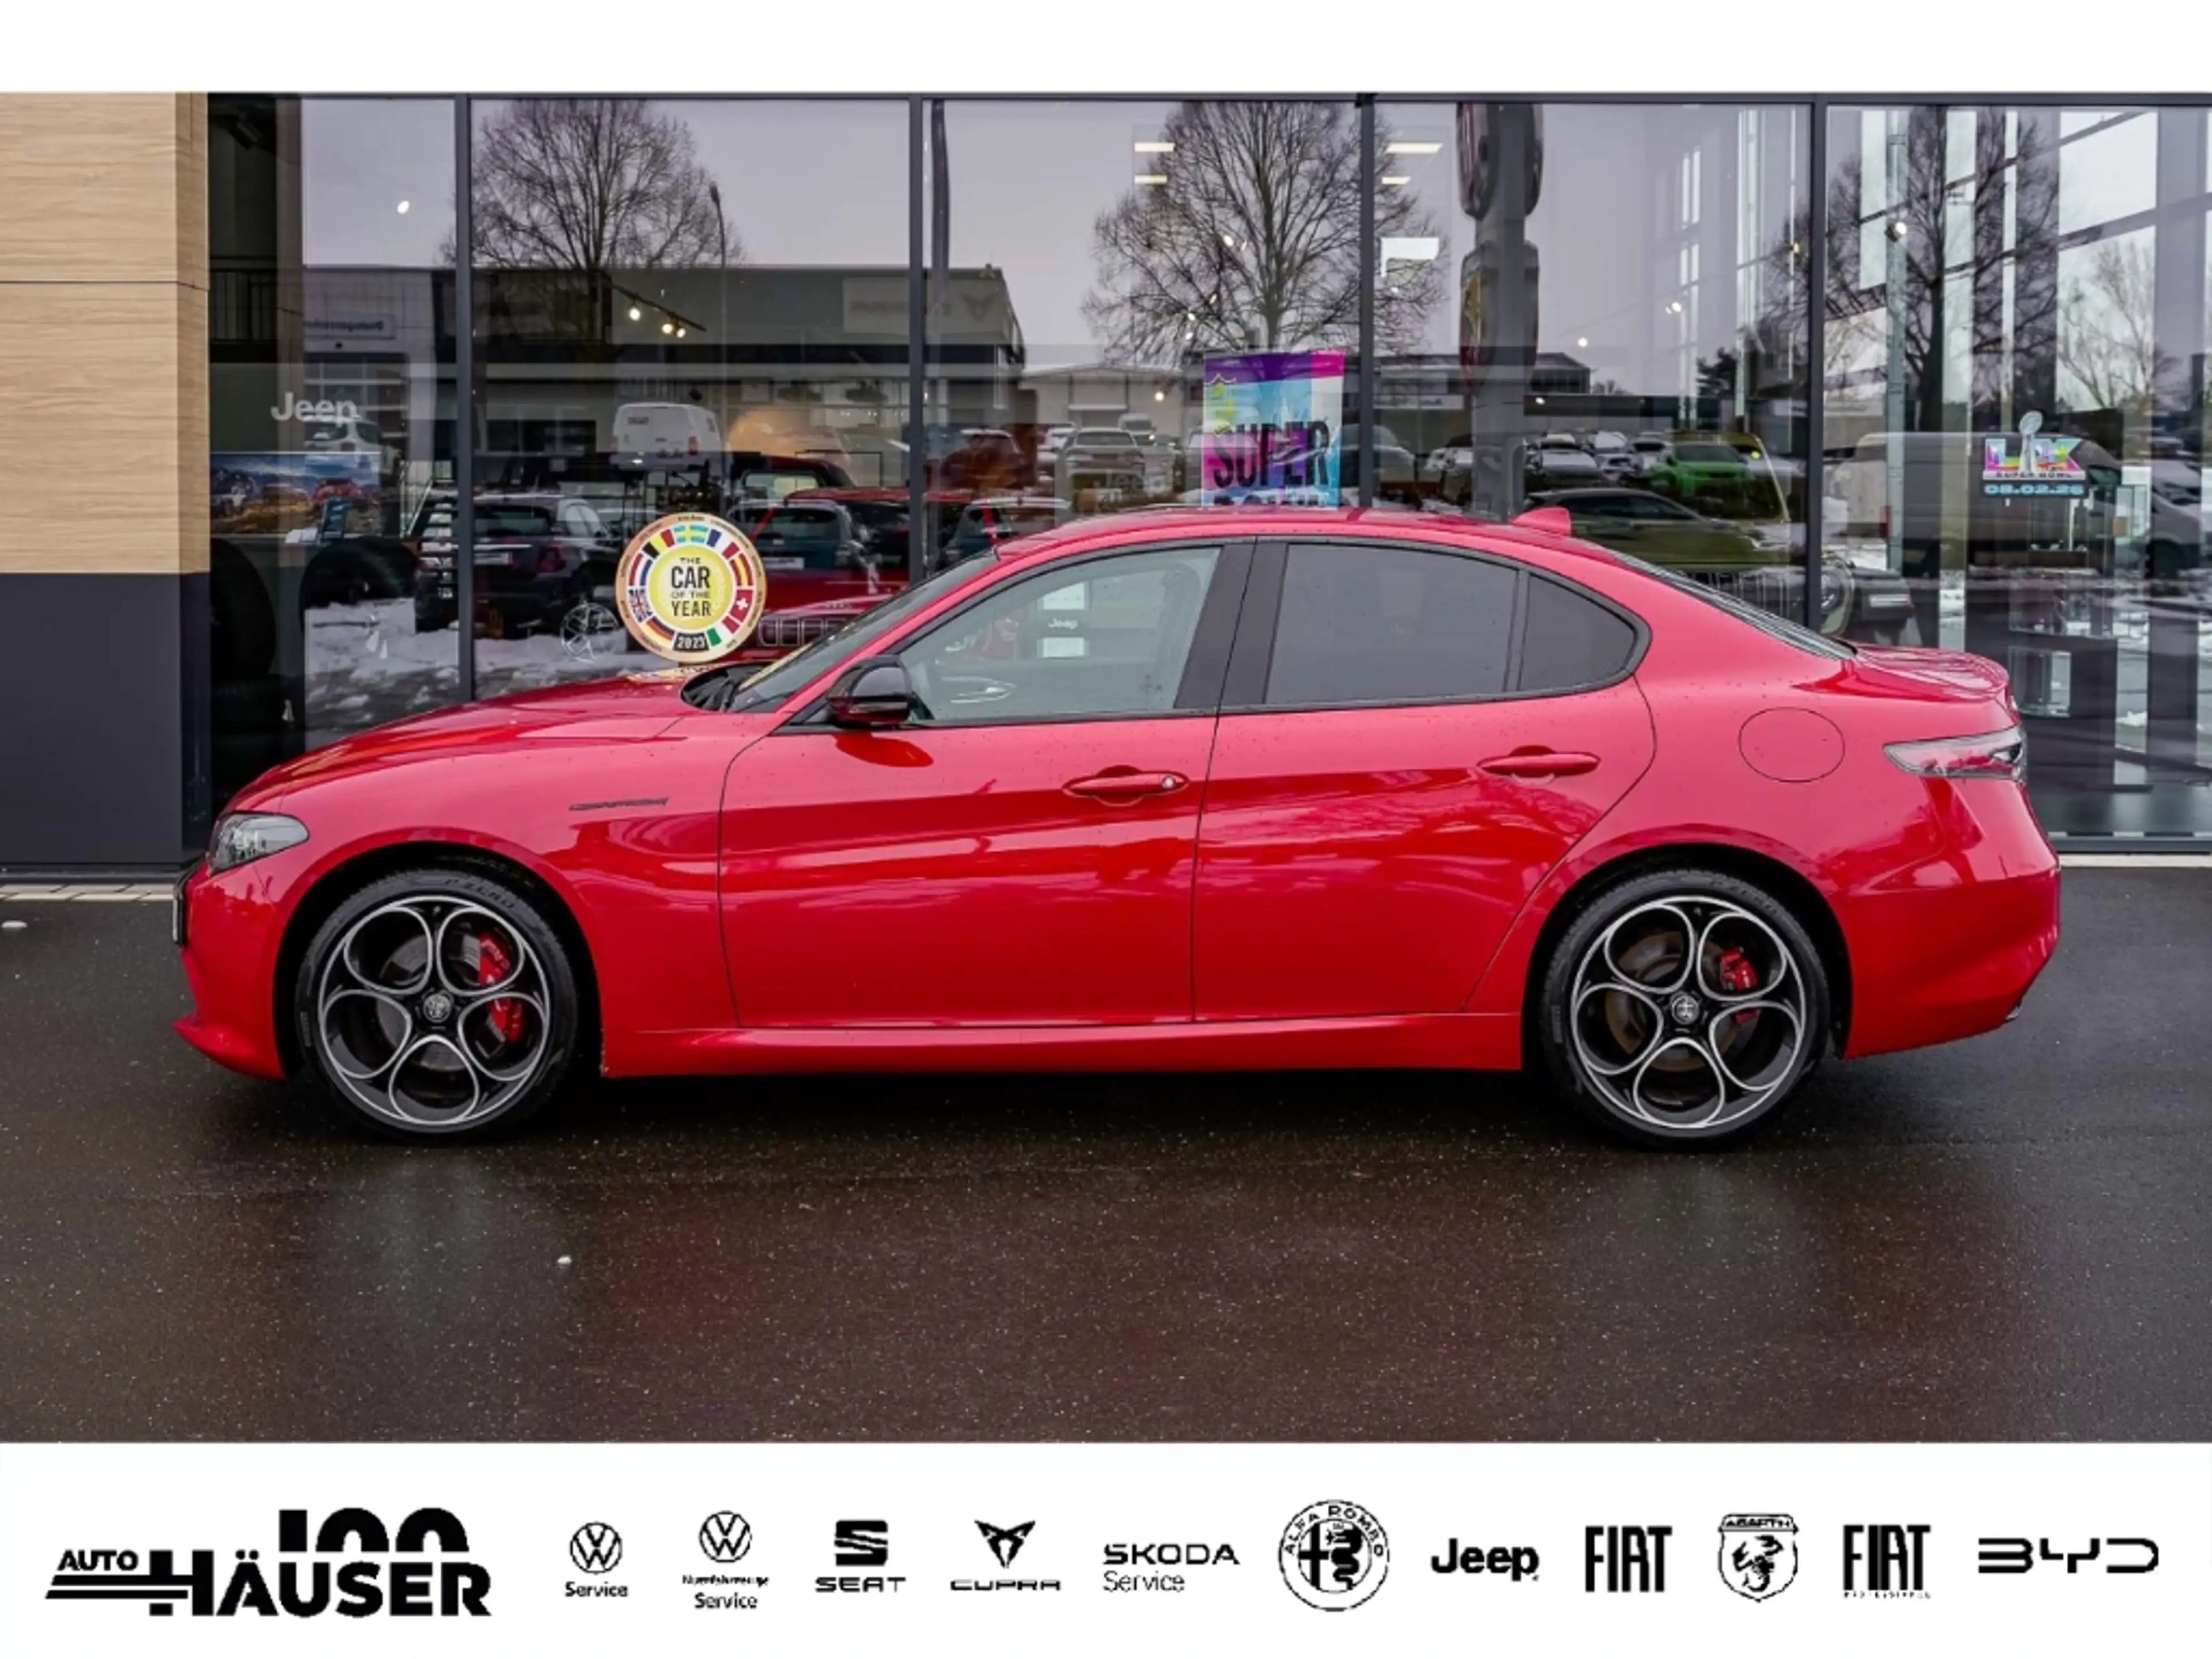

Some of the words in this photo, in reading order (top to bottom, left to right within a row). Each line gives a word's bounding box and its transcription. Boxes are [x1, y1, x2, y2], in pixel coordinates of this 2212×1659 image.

[270, 392, 358, 428] Jeep
[1213, 421, 1330, 488] SUPER
[671, 566, 710, 589] CAR
[671, 601, 711, 616] YEAR
[1048, 618, 1078, 630] Jeep
[677, 637, 706, 649] 2023
